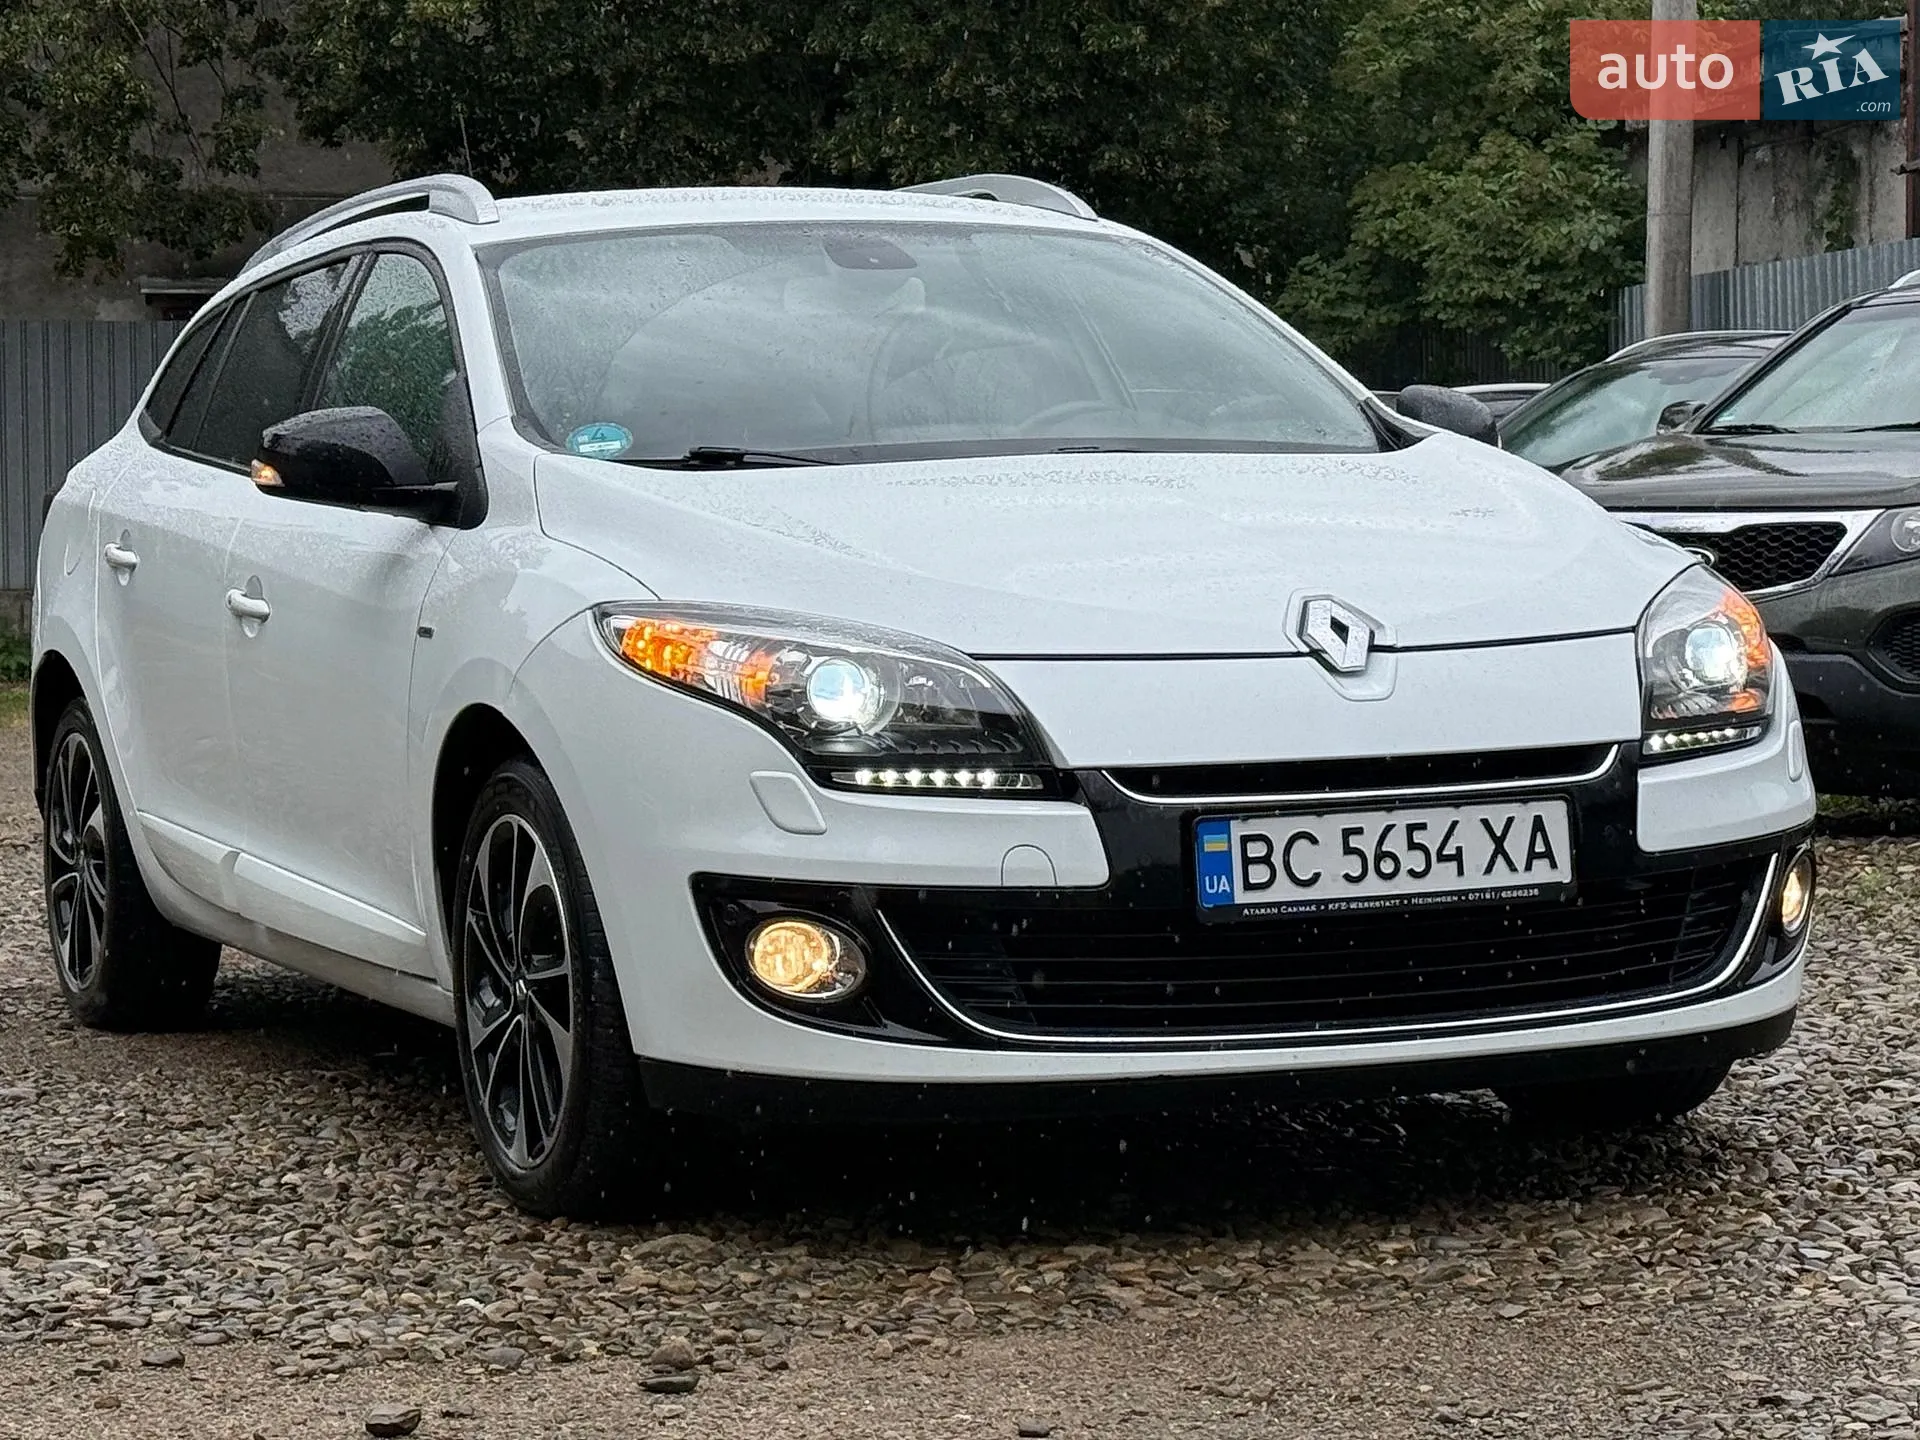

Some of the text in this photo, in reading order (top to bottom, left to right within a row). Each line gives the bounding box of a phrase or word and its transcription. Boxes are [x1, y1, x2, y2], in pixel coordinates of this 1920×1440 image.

[1239, 814, 1559, 892] BC 5654 XA
[1205, 875, 1230, 893] UA
